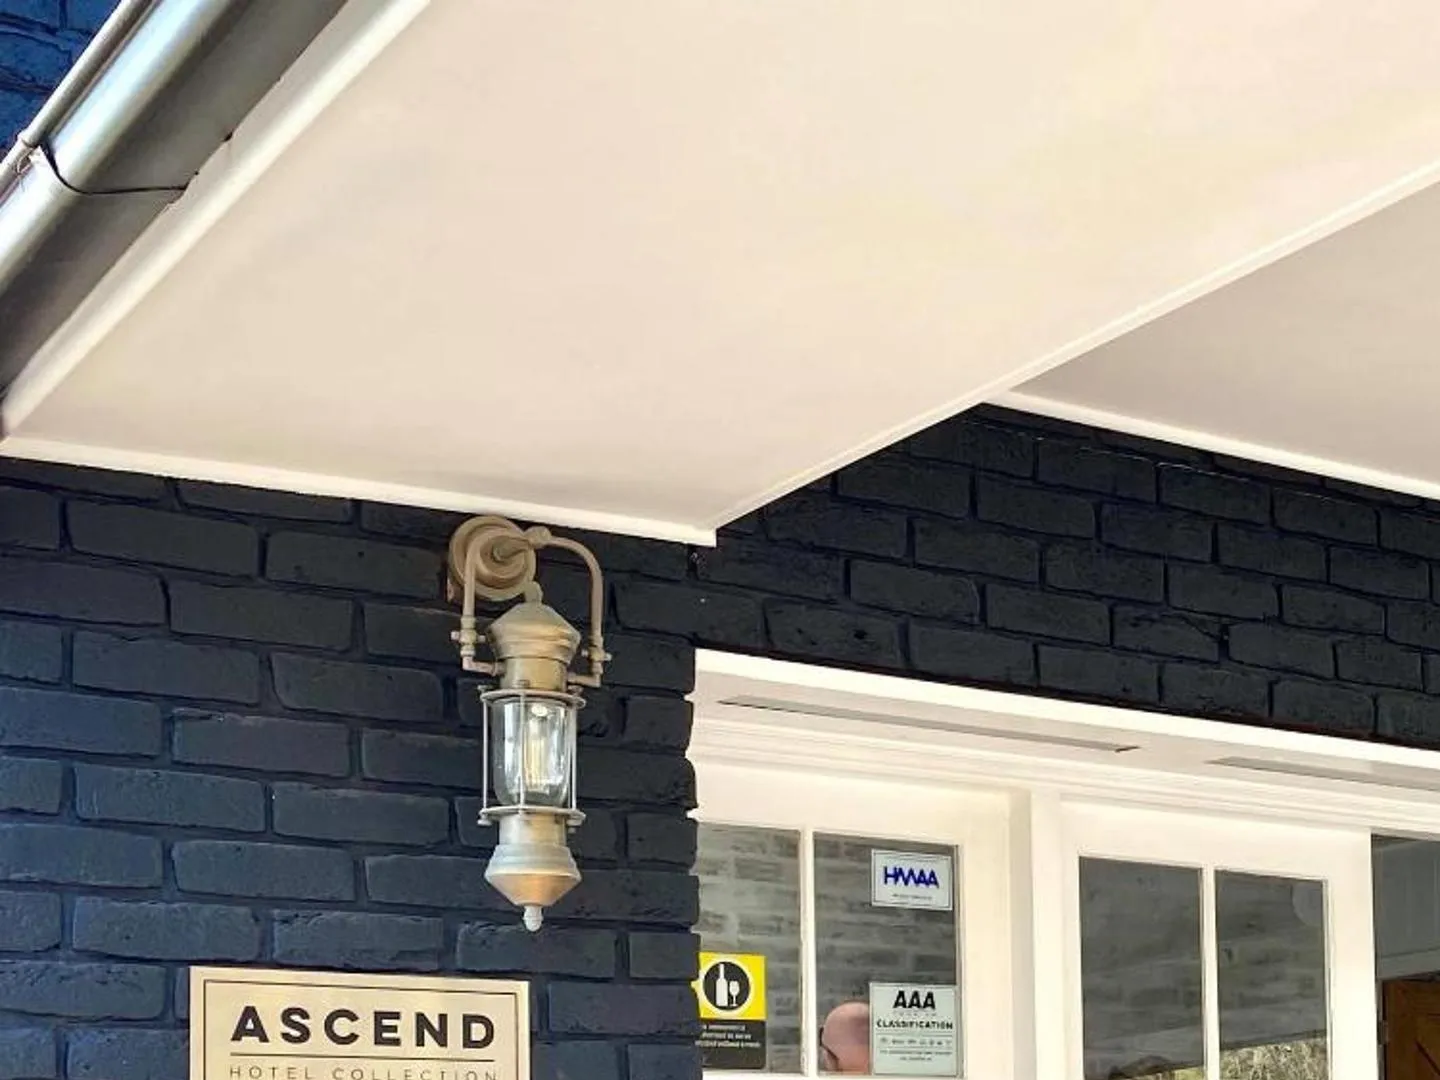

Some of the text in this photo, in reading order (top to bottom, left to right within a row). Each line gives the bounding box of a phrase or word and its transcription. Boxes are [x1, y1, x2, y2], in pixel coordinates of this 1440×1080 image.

[892, 990, 936, 1010] AAA
[231, 1005, 494, 1049] ASCEND
[876, 1019, 953, 1030] CLASSIFICATION
[229, 1065, 313, 1080] HOTEL
